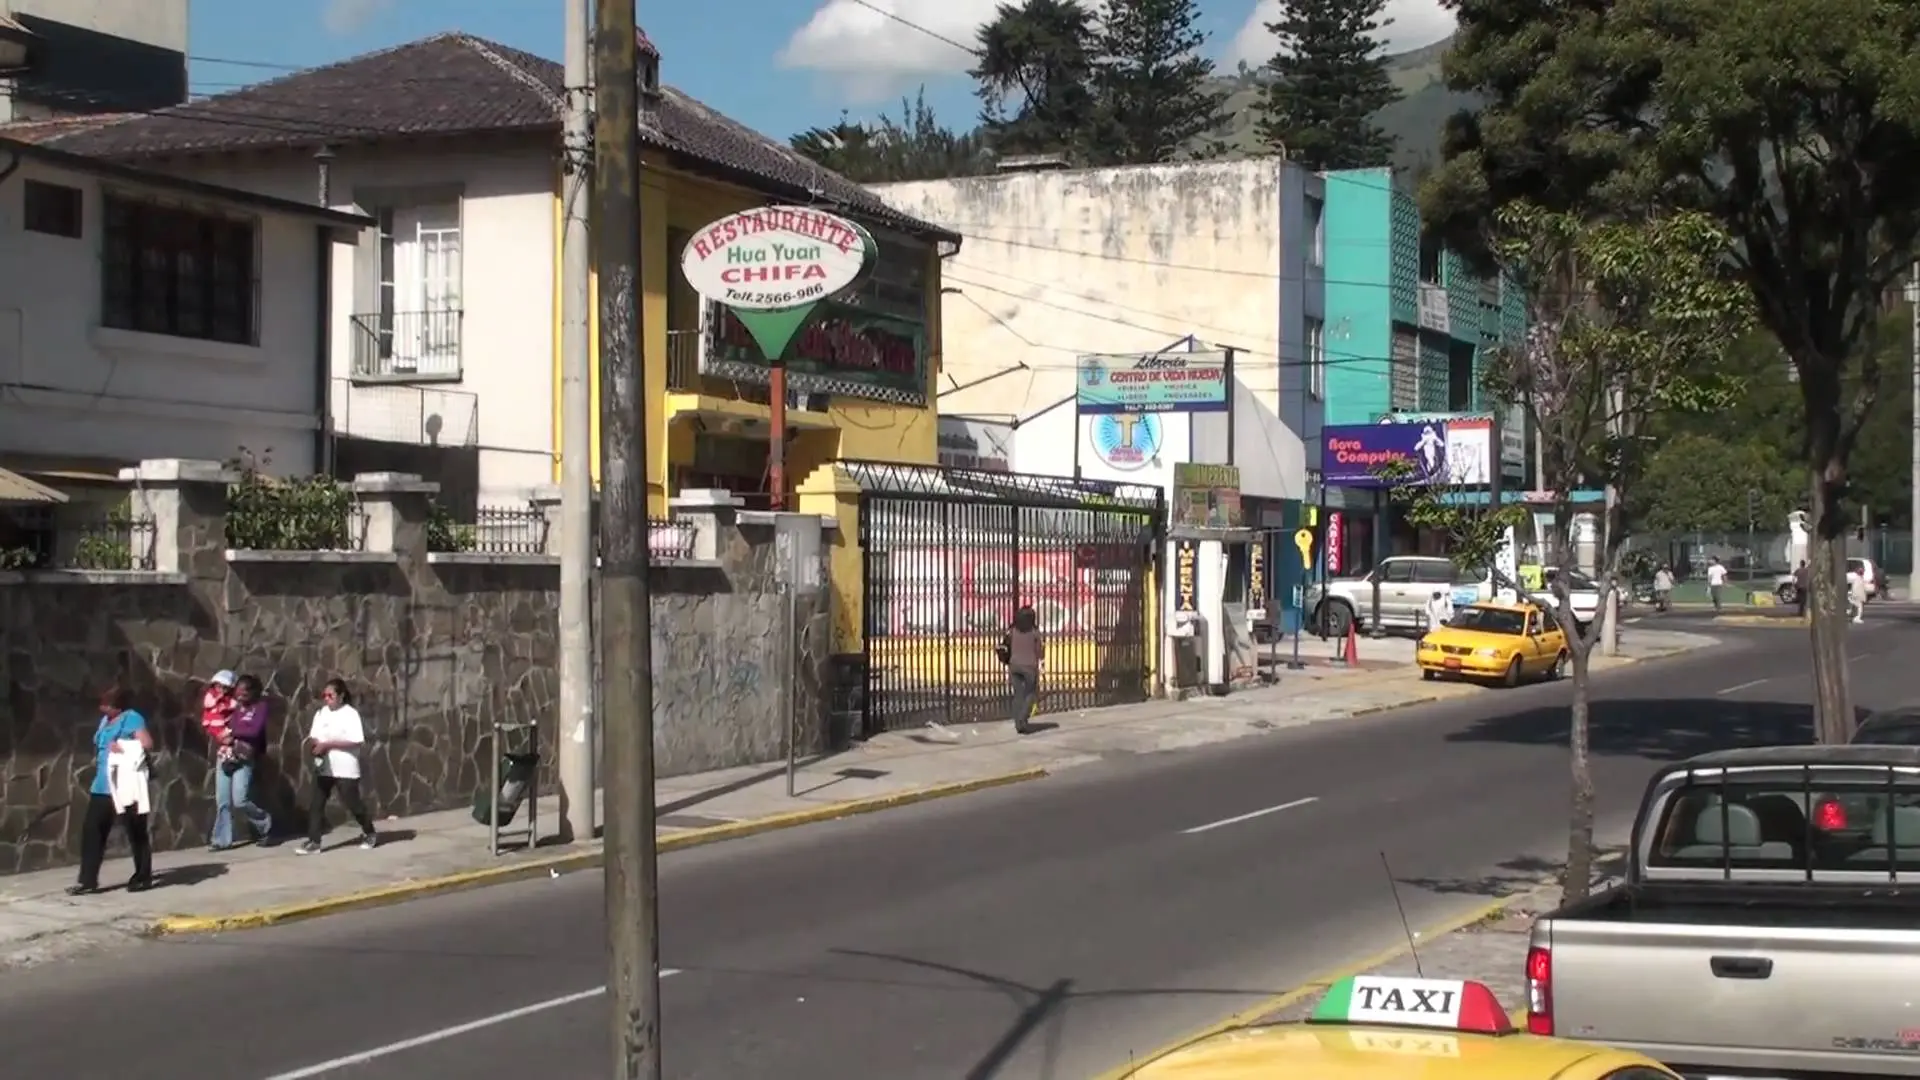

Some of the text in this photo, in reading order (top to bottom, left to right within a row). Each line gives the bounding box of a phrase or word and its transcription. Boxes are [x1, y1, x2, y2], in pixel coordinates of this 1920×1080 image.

[694, 208, 857, 261] RESTAURANTE
[727, 243, 821, 264] Hua Yuan
[720, 263, 827, 283] CHIFA
[1110, 371, 1147, 383] CENTRO
[1149, 371, 1162, 381] DE
[1163, 370, 1186, 381] VIDA
[1187, 368, 1220, 380] NUEVA
[1358, 985, 1456, 1014] TAXI
